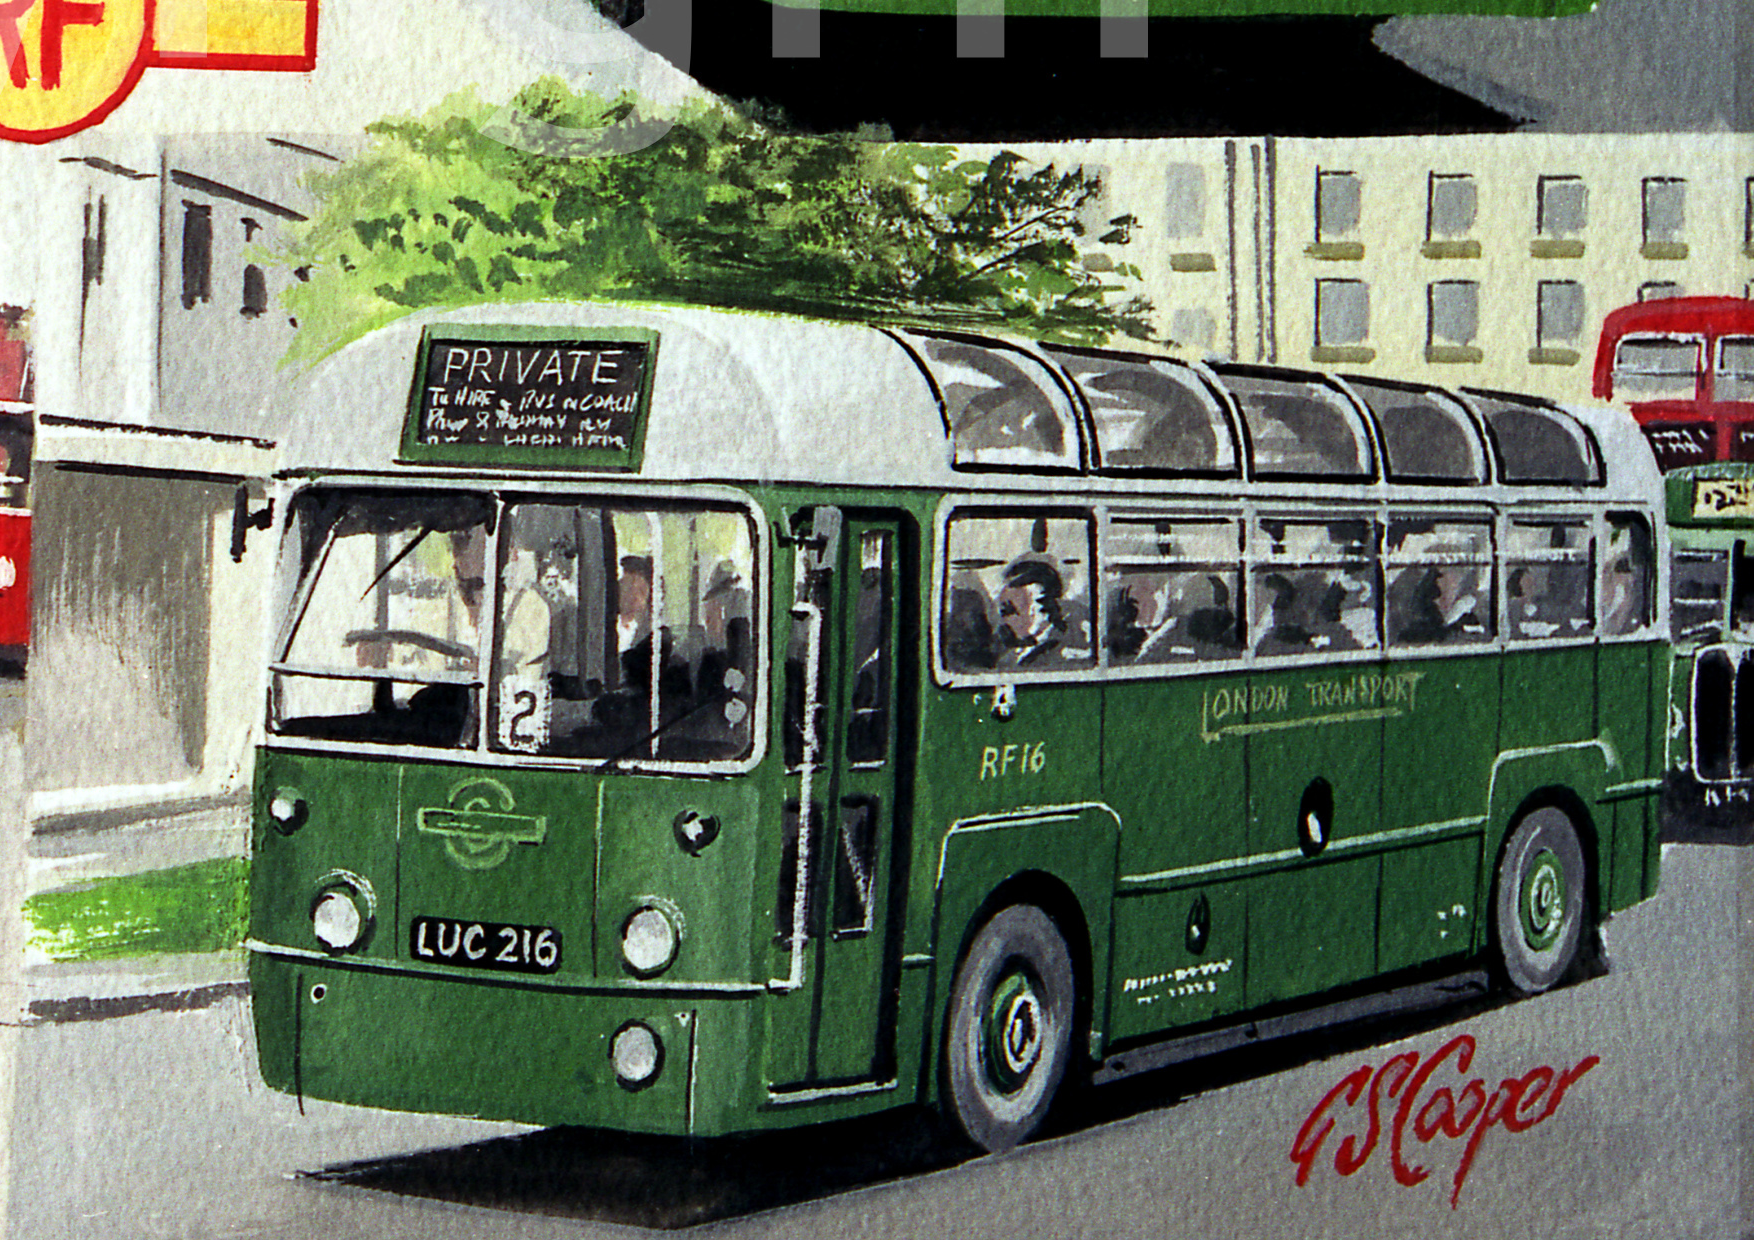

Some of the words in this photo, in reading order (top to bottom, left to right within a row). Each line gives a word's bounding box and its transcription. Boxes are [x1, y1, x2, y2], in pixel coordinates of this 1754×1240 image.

[444, 347, 624, 386] PRIVATE
[509, 690, 538, 746] 2
[1201, 685, 1289, 743] LONDON
[1306, 670, 1427, 711] TRANSPORT
